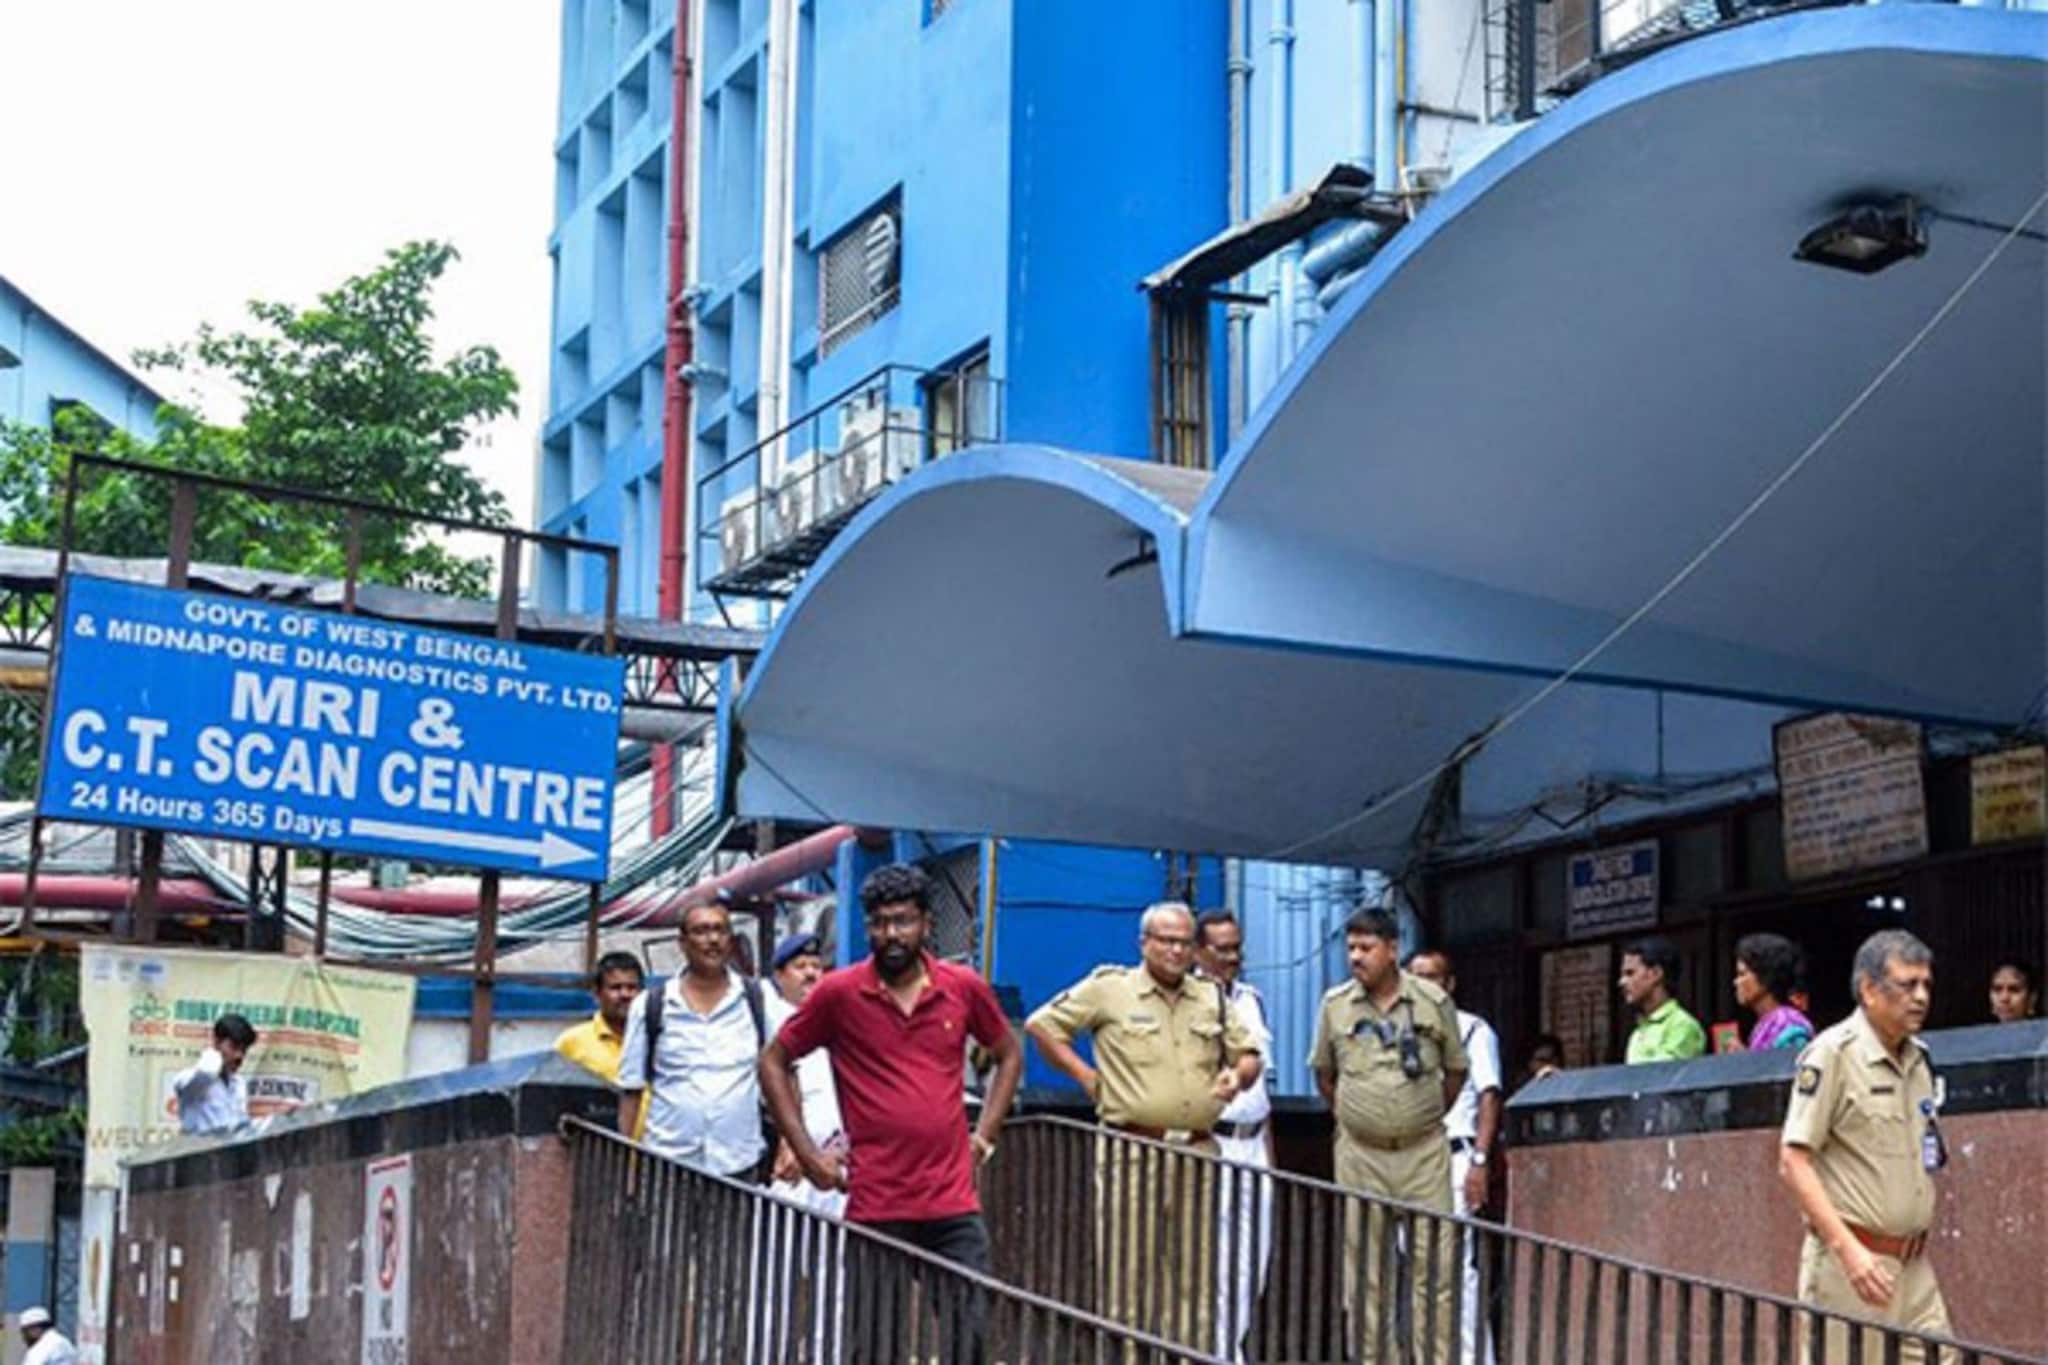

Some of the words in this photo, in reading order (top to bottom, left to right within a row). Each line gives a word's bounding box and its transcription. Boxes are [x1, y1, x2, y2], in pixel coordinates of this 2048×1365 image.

[74, 614, 96, 637] &
[107, 619, 286, 665] MIDNAPORE
[295, 647, 488, 694] DIAGNOSTICS
[497, 677, 554, 704] PVT.
[562, 688, 618, 714] LTD.
[184, 599, 270, 634] GOVT.
[280, 615, 316, 638] OF
[327, 622, 407, 652] WEST
[416, 636, 528, 671] BENGAL
[231, 671, 379, 738] MRI
[409, 698, 464, 750] &
[63, 709, 172, 776] C.T.
[194, 726, 360, 800] SCAN
[379, 751, 605, 831] CENTRE
[71, 781, 108, 812] 24
[117, 787, 203, 820] Hours
[213, 799, 265, 829] 365
[274, 806, 343, 842] Days
